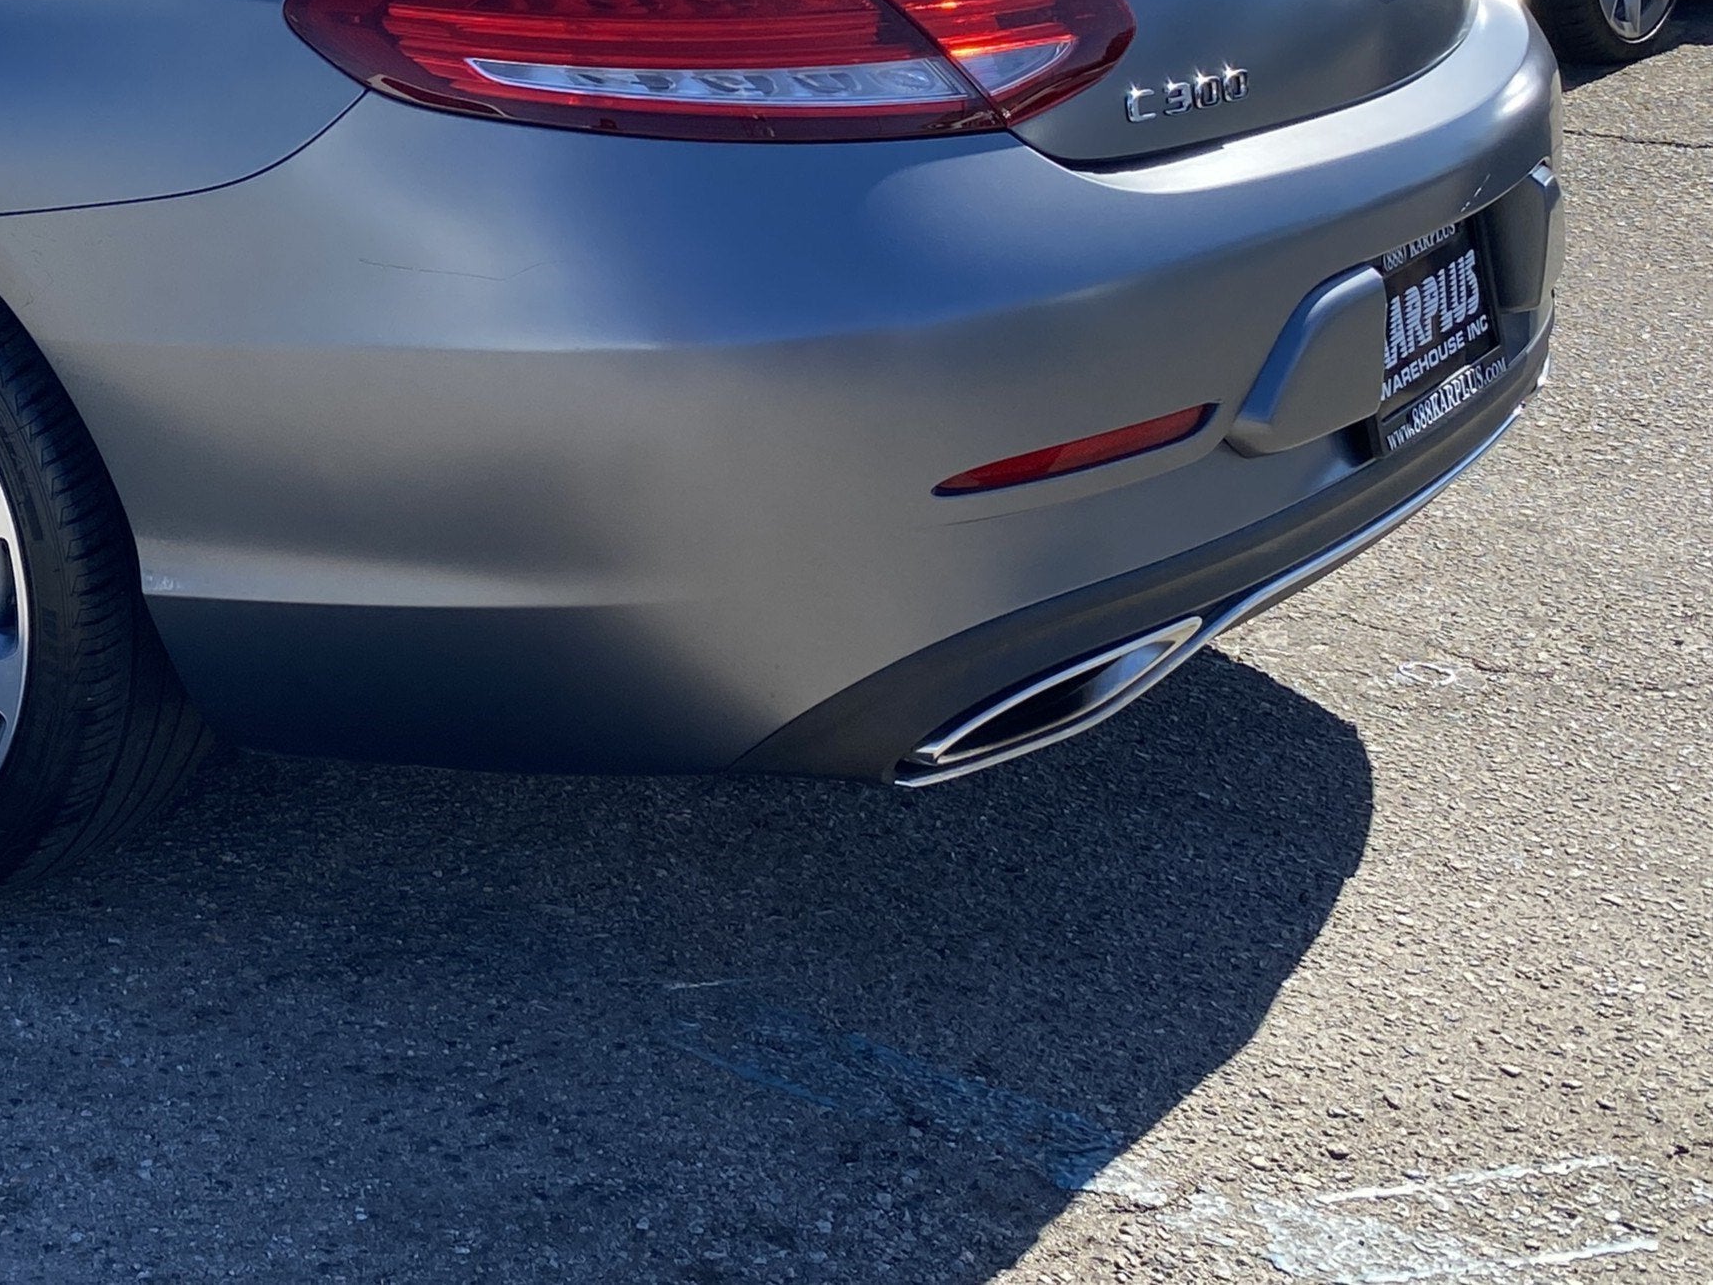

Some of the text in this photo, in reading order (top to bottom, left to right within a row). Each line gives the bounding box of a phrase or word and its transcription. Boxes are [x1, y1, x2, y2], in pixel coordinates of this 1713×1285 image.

[1126, 67, 1249, 123] C 300
[1384, 248, 1480, 370] ARPLUS
[1380, 314, 1489, 402] WAREHOUSE INC
